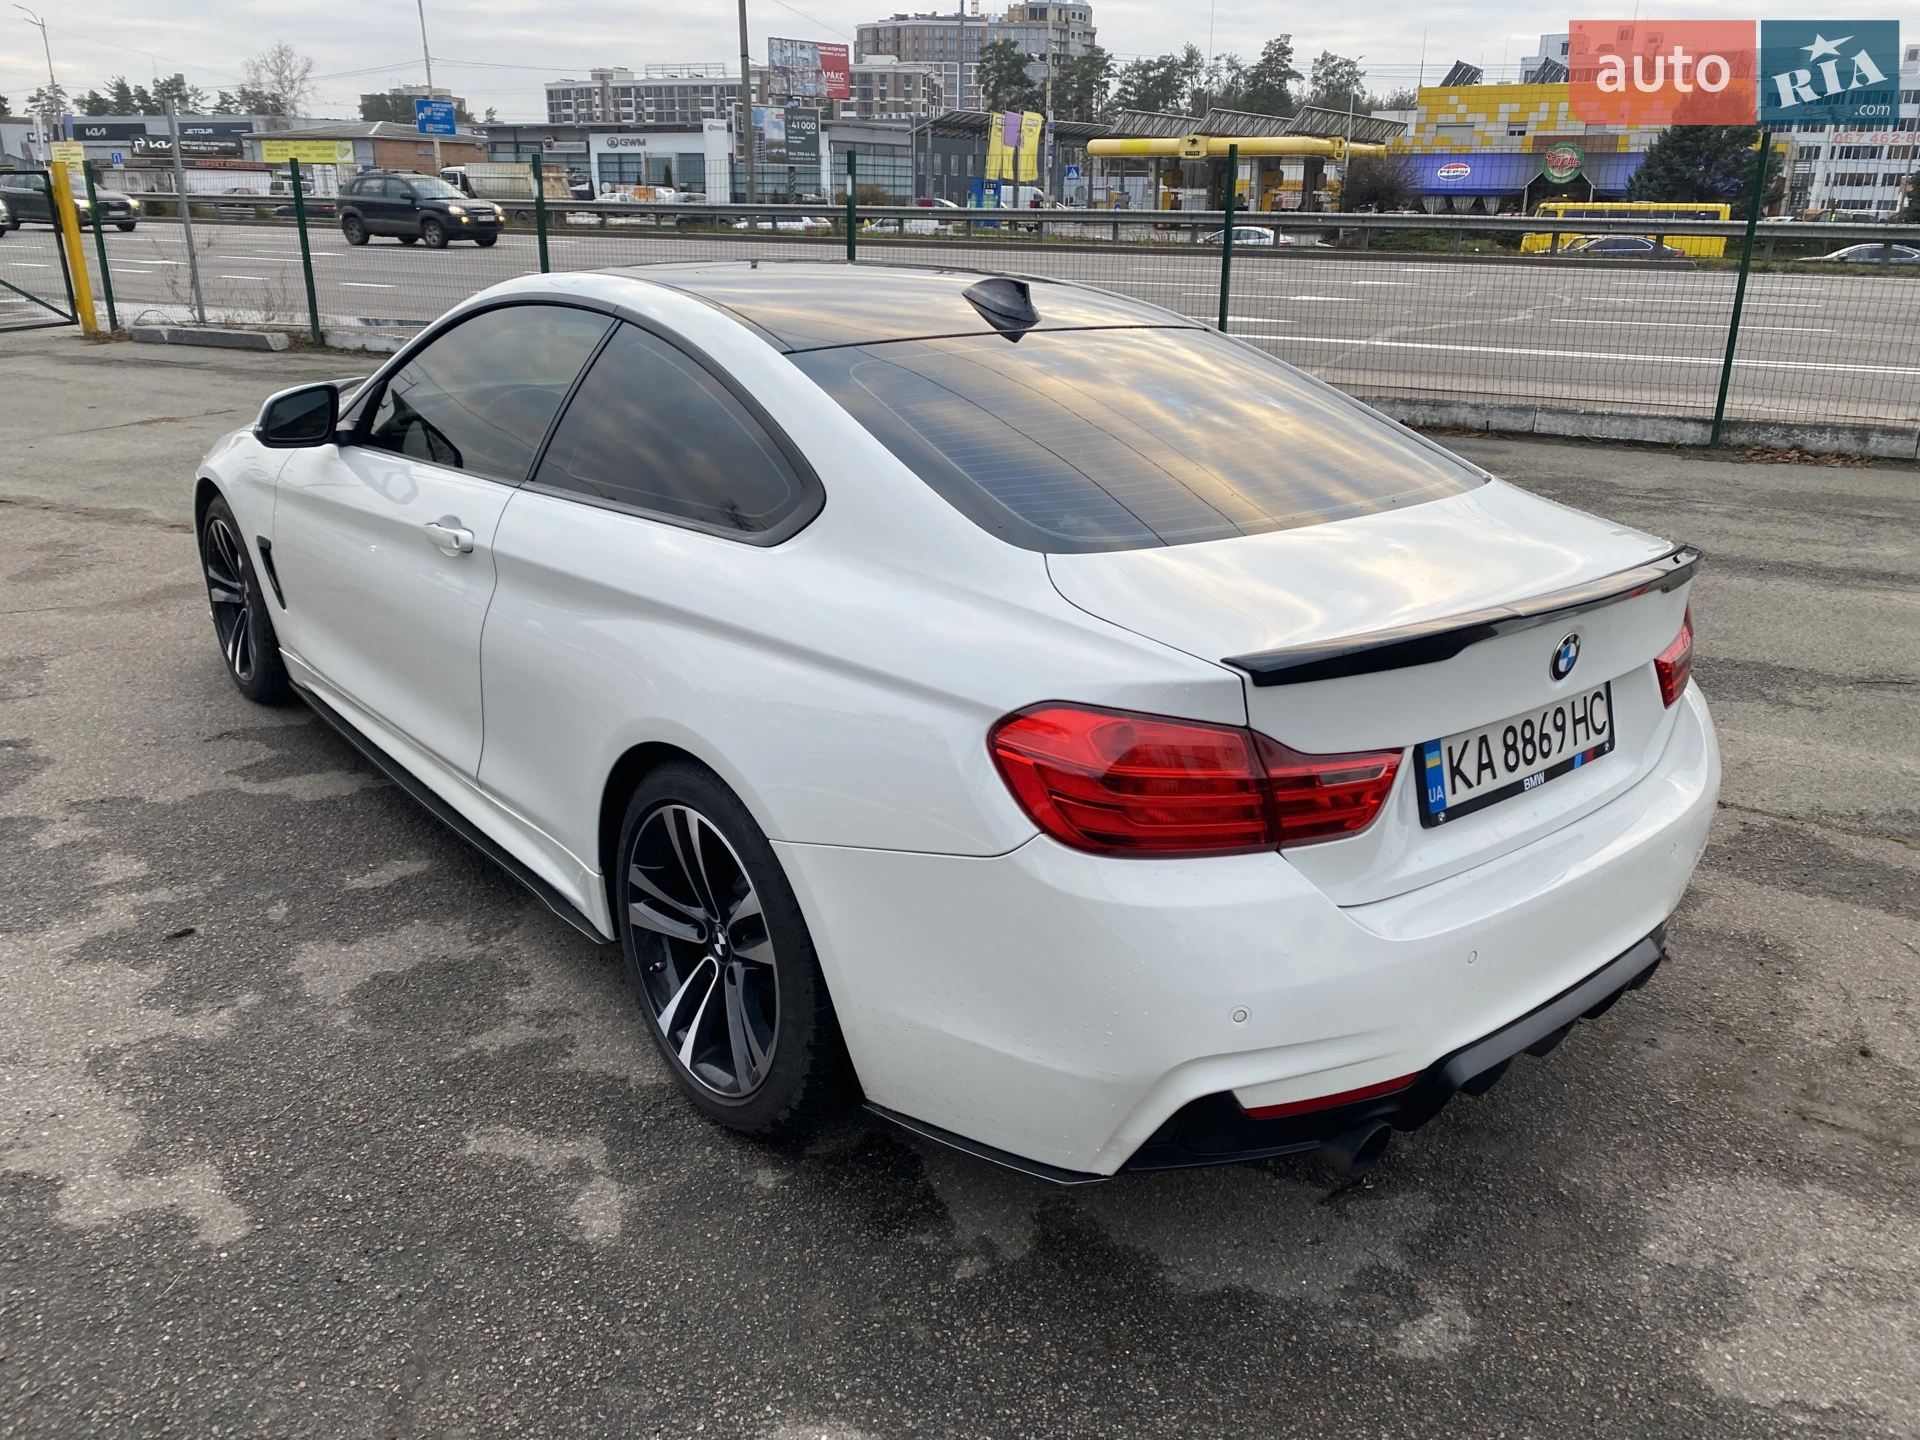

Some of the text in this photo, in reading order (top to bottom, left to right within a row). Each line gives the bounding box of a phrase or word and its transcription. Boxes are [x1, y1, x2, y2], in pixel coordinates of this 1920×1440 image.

[86, 128, 106, 136] KIA
[1834, 133, 1863, 143] 067
[620, 138, 646, 147] GWM
[1502, 706, 1567, 773] 8869
[1523, 771, 1545, 791] BMW
[1428, 788, 1445, 803] UA
